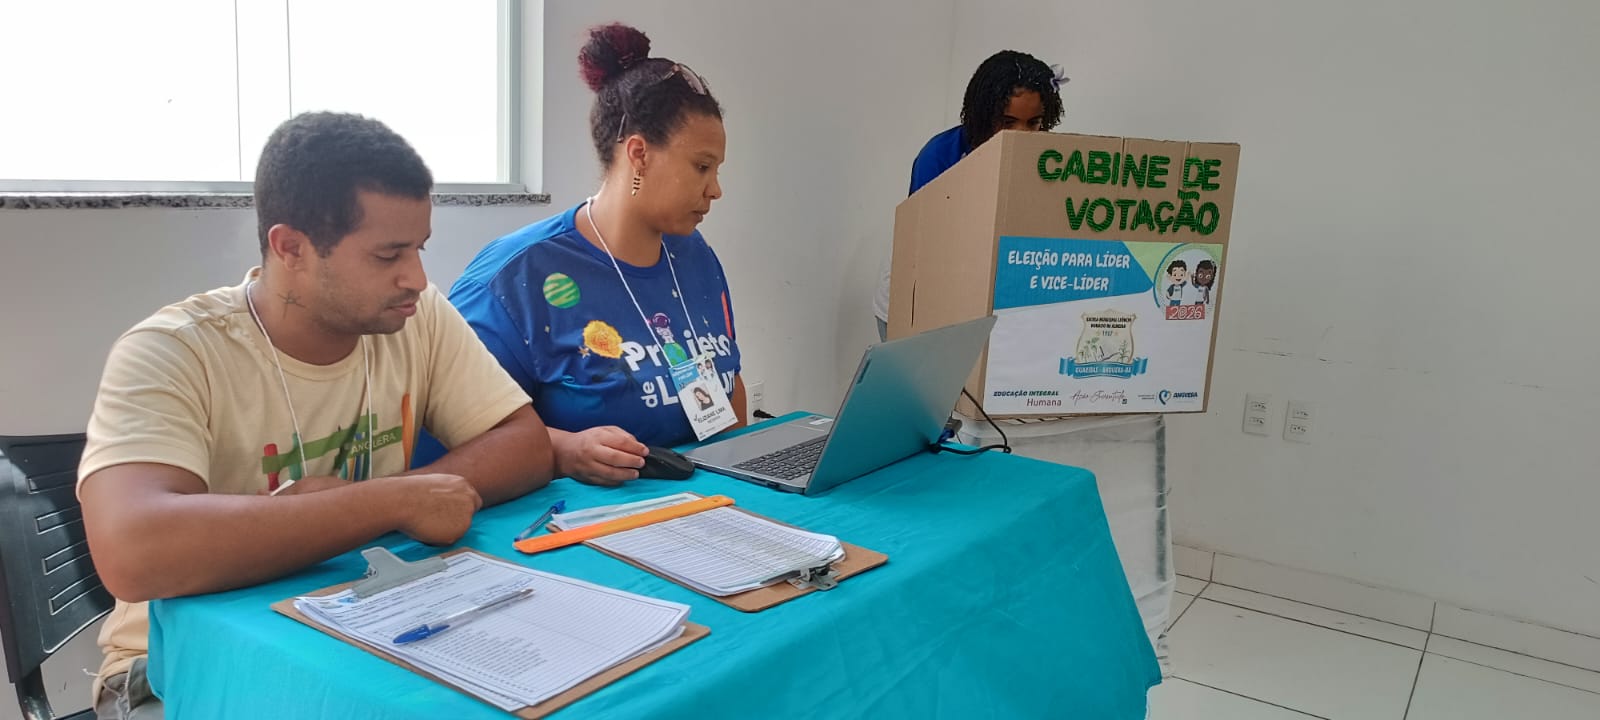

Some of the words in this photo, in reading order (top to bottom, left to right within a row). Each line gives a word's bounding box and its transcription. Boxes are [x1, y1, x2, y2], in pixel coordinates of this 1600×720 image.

[1037, 149, 1170, 189] CABINE
[1183, 157, 1221, 191] DE
[1065, 189, 1220, 235] VOTAÇÃO
[1008, 249, 1058, 270] ELEIÇÃO
[1061, 252, 1092, 267] PARA
[1096, 250, 1130, 269] LÍDER
[1030, 275, 1038, 289] E
[1041, 273, 1109, 291] VICE-LÍDER
[1168, 305, 1204, 320] 2026
[641, 381, 659, 408] de
[993, 389, 1028, 398] EDUCAÇÃO
[1026, 398, 1062, 407] Humana
